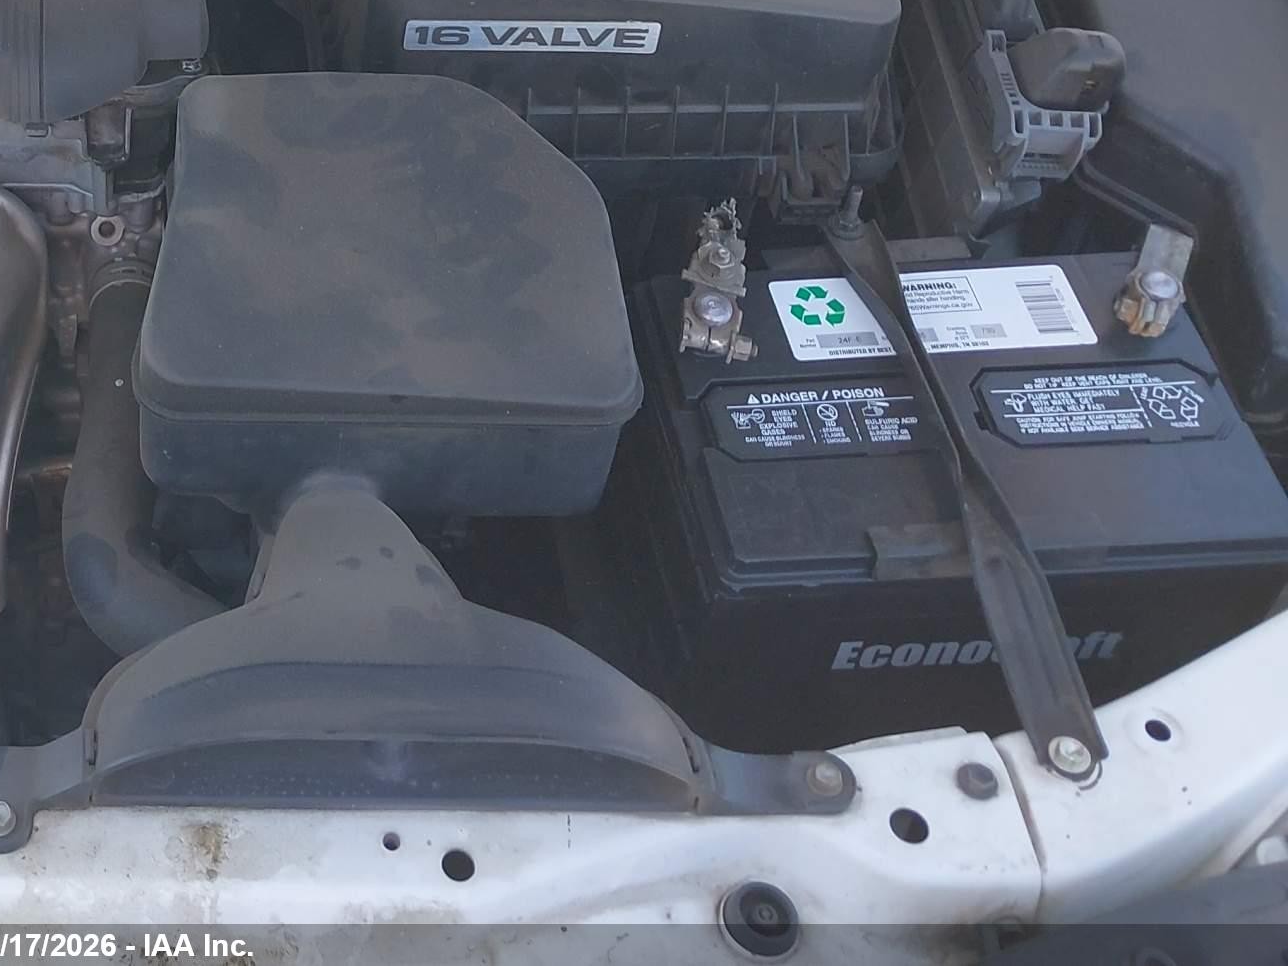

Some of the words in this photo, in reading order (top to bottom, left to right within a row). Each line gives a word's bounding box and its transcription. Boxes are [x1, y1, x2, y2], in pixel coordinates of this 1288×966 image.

[415, 25, 471, 46] 16
[481, 26, 650, 49] VALVE
[828, 347, 868, 356] DISTRIBUTED
[761, 391, 819, 404] DANGER
[821, 390, 829, 401] /
[831, 387, 885, 400] POISON
[1027, 392, 1051, 401] FLUSH
[1051, 391, 1072, 400] EYES
[1072, 389, 1120, 398] IMMEDIATELY
[1030, 399, 1050, 408] WITH
[1078, 397, 1094, 405] GET
[1032, 405, 1066, 414] MEDICAL
[1066, 404, 1085, 412] HELP
[1086, 403, 1106, 411] FAST
[759, 421, 799, 430] EXPLOSIVE
[864, 417, 900, 426] SULFURIC
[900, 416, 918, 425] ACID
[761, 428, 786, 436] GASES
